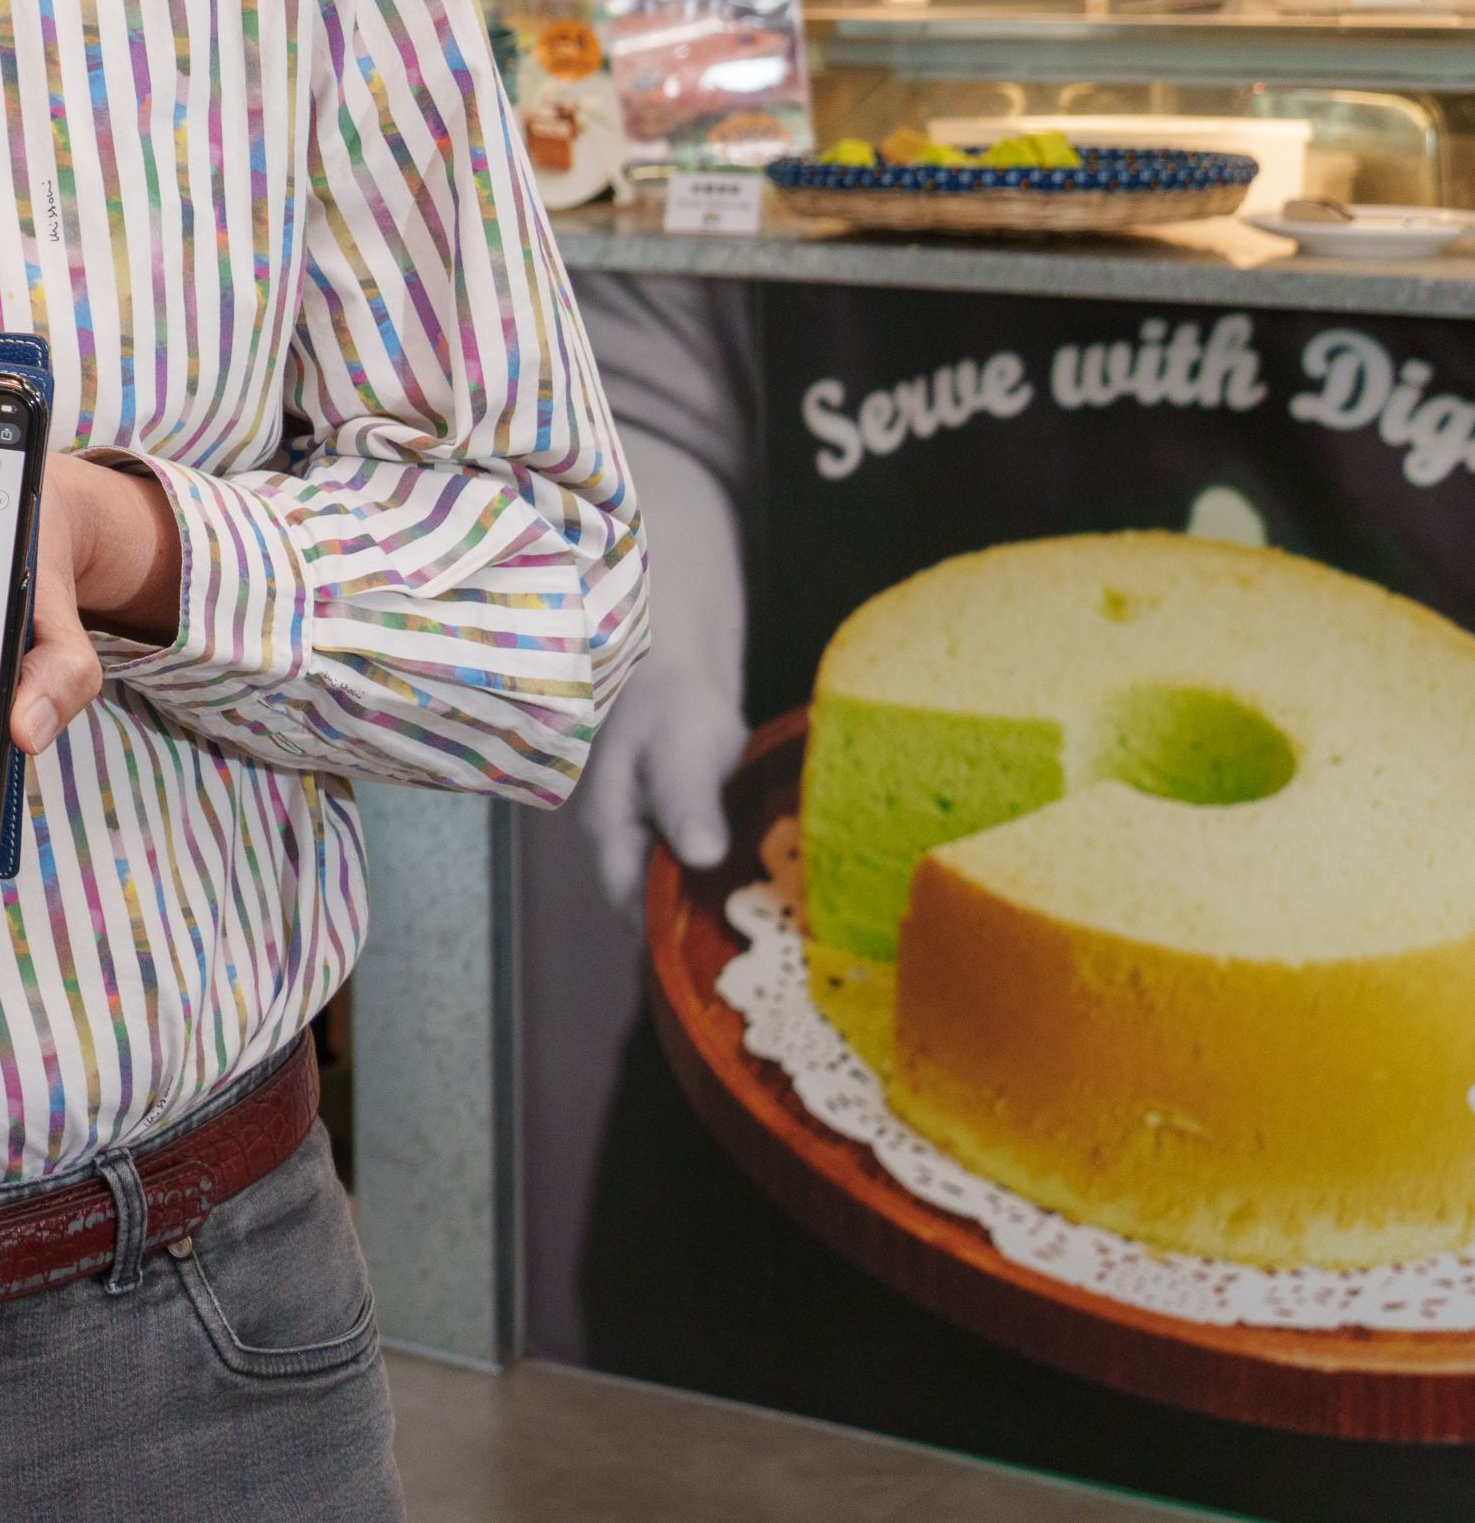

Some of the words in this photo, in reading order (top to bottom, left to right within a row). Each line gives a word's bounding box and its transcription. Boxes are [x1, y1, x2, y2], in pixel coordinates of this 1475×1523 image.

[802, 350, 1035, 480] Serve
[1050, 313, 1268, 413] with
[1289, 328, 1475, 488] Dig
